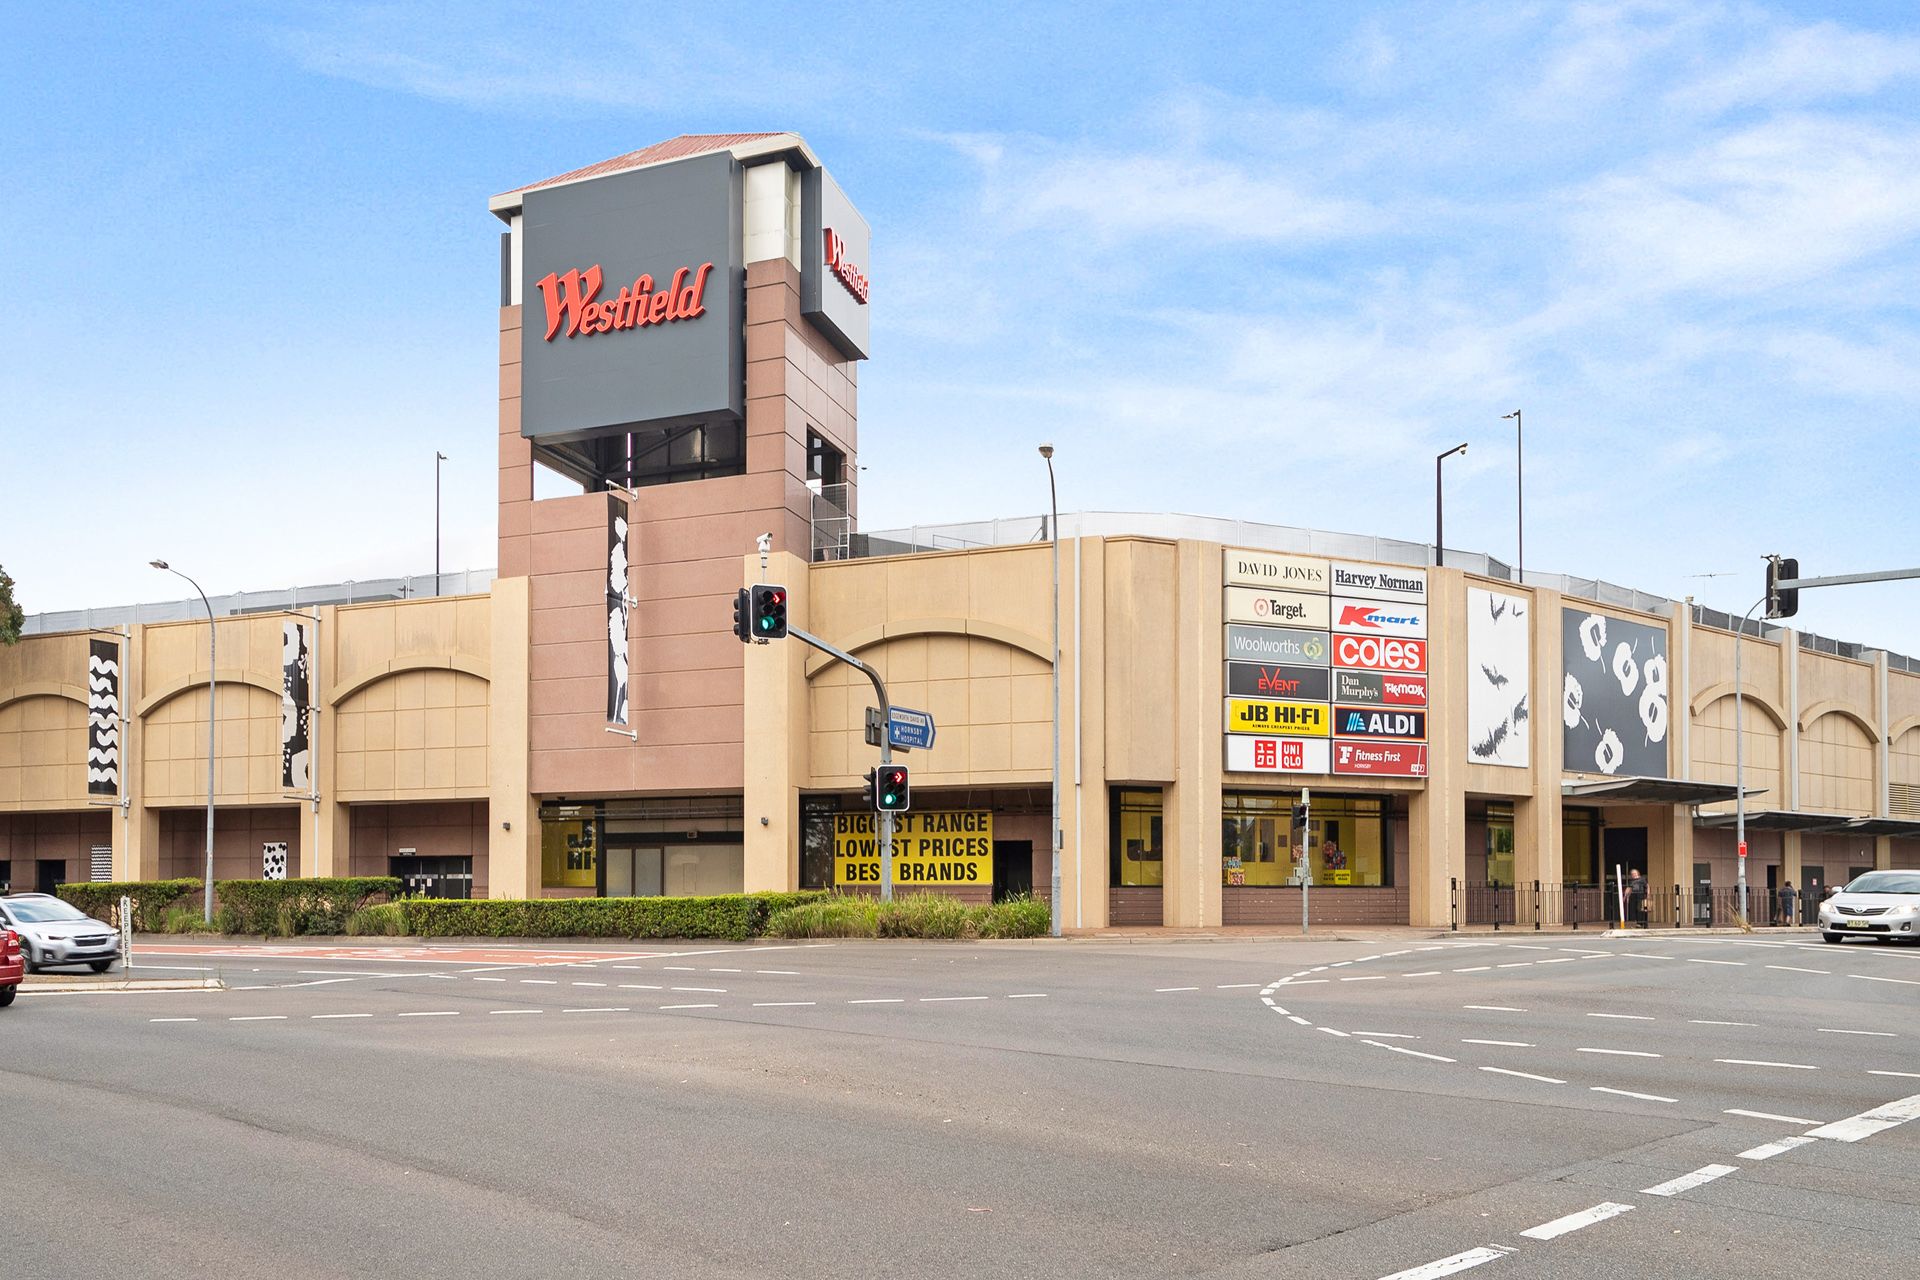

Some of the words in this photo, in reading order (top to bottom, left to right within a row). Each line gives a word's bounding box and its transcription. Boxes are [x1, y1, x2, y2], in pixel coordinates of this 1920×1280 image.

[822, 227, 869, 305] Westfield
[535, 262, 713, 342] Westfield
[1238, 561, 1278, 577] DAVID
[1282, 566, 1322, 582] JONES
[1335, 569, 1377, 589] Harvey
[1379, 573, 1424, 592] Norman
[1338, 605, 1420, 628] Kmart
[1234, 636, 1300, 655] Woolworths
[1339, 637, 1420, 669] coles
[1258, 667, 1300, 691] EVENT
[1341, 675, 1359, 686] Dan
[1341, 685, 1379, 699] Murphy's
[1240, 705, 1269, 722] JB
[1275, 706, 1320, 725] HI-FI
[1368, 713, 1415, 734] ALDI
[901, 725, 923, 735] HORNSBY
[901, 734, 923, 745] HOSPITAL
[1355, 749, 1383, 761] Fitness
[1383, 750, 1401, 763] First
[837, 814, 915, 834] BIGGST
[923, 813, 988, 832] RANGE
[919, 837, 989, 856] PRICES
[846, 863, 880, 881] BES
[900, 862, 978, 881] BRANDS
